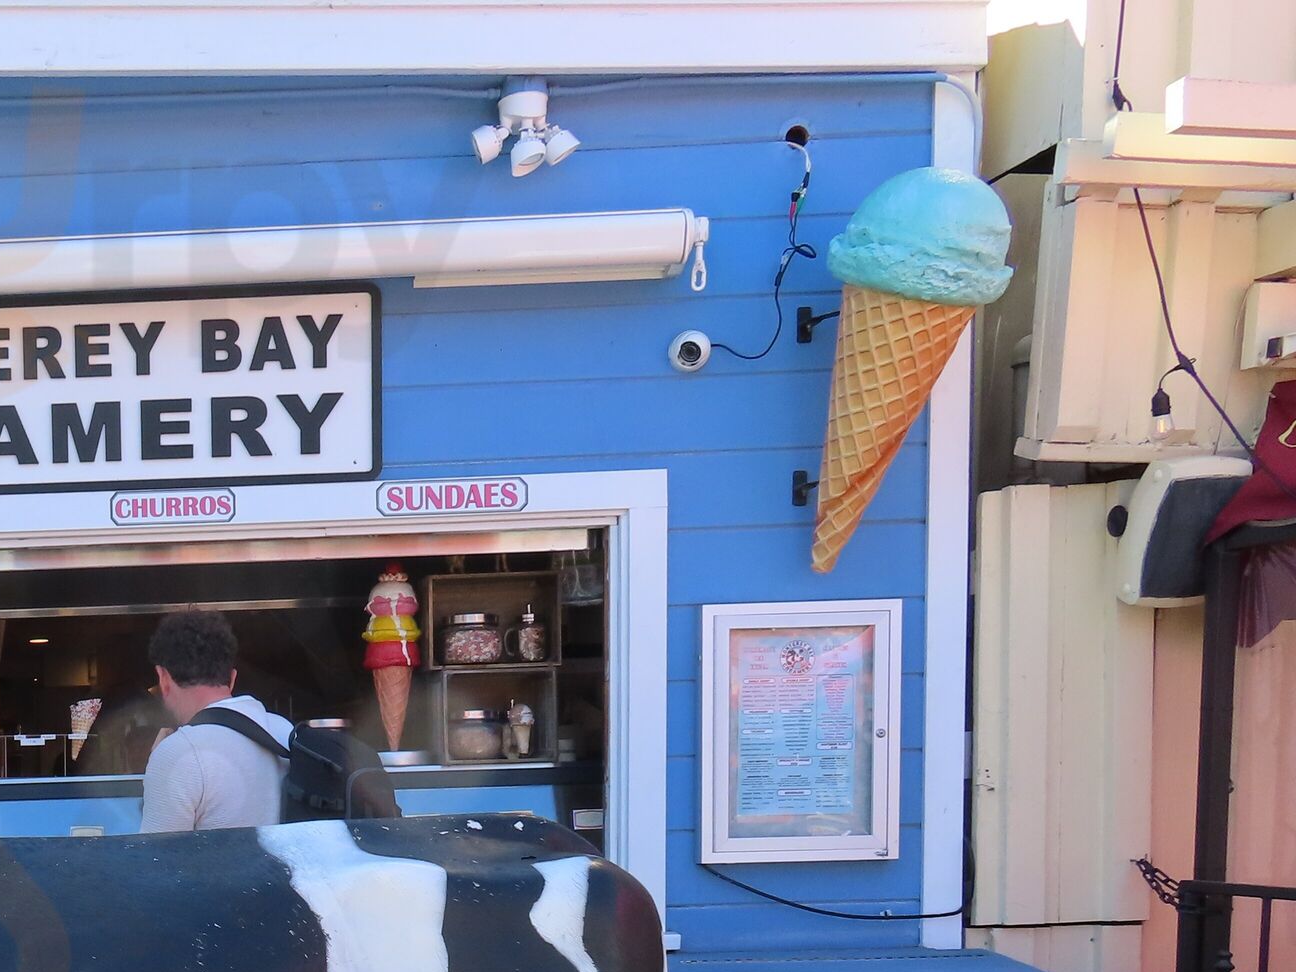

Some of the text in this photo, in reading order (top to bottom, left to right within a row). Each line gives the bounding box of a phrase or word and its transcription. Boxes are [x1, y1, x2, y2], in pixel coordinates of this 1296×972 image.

[201, 313, 344, 375] BAY
[114, 493, 232, 519] CHURROS
[386, 483, 518, 512] SUNDAES
